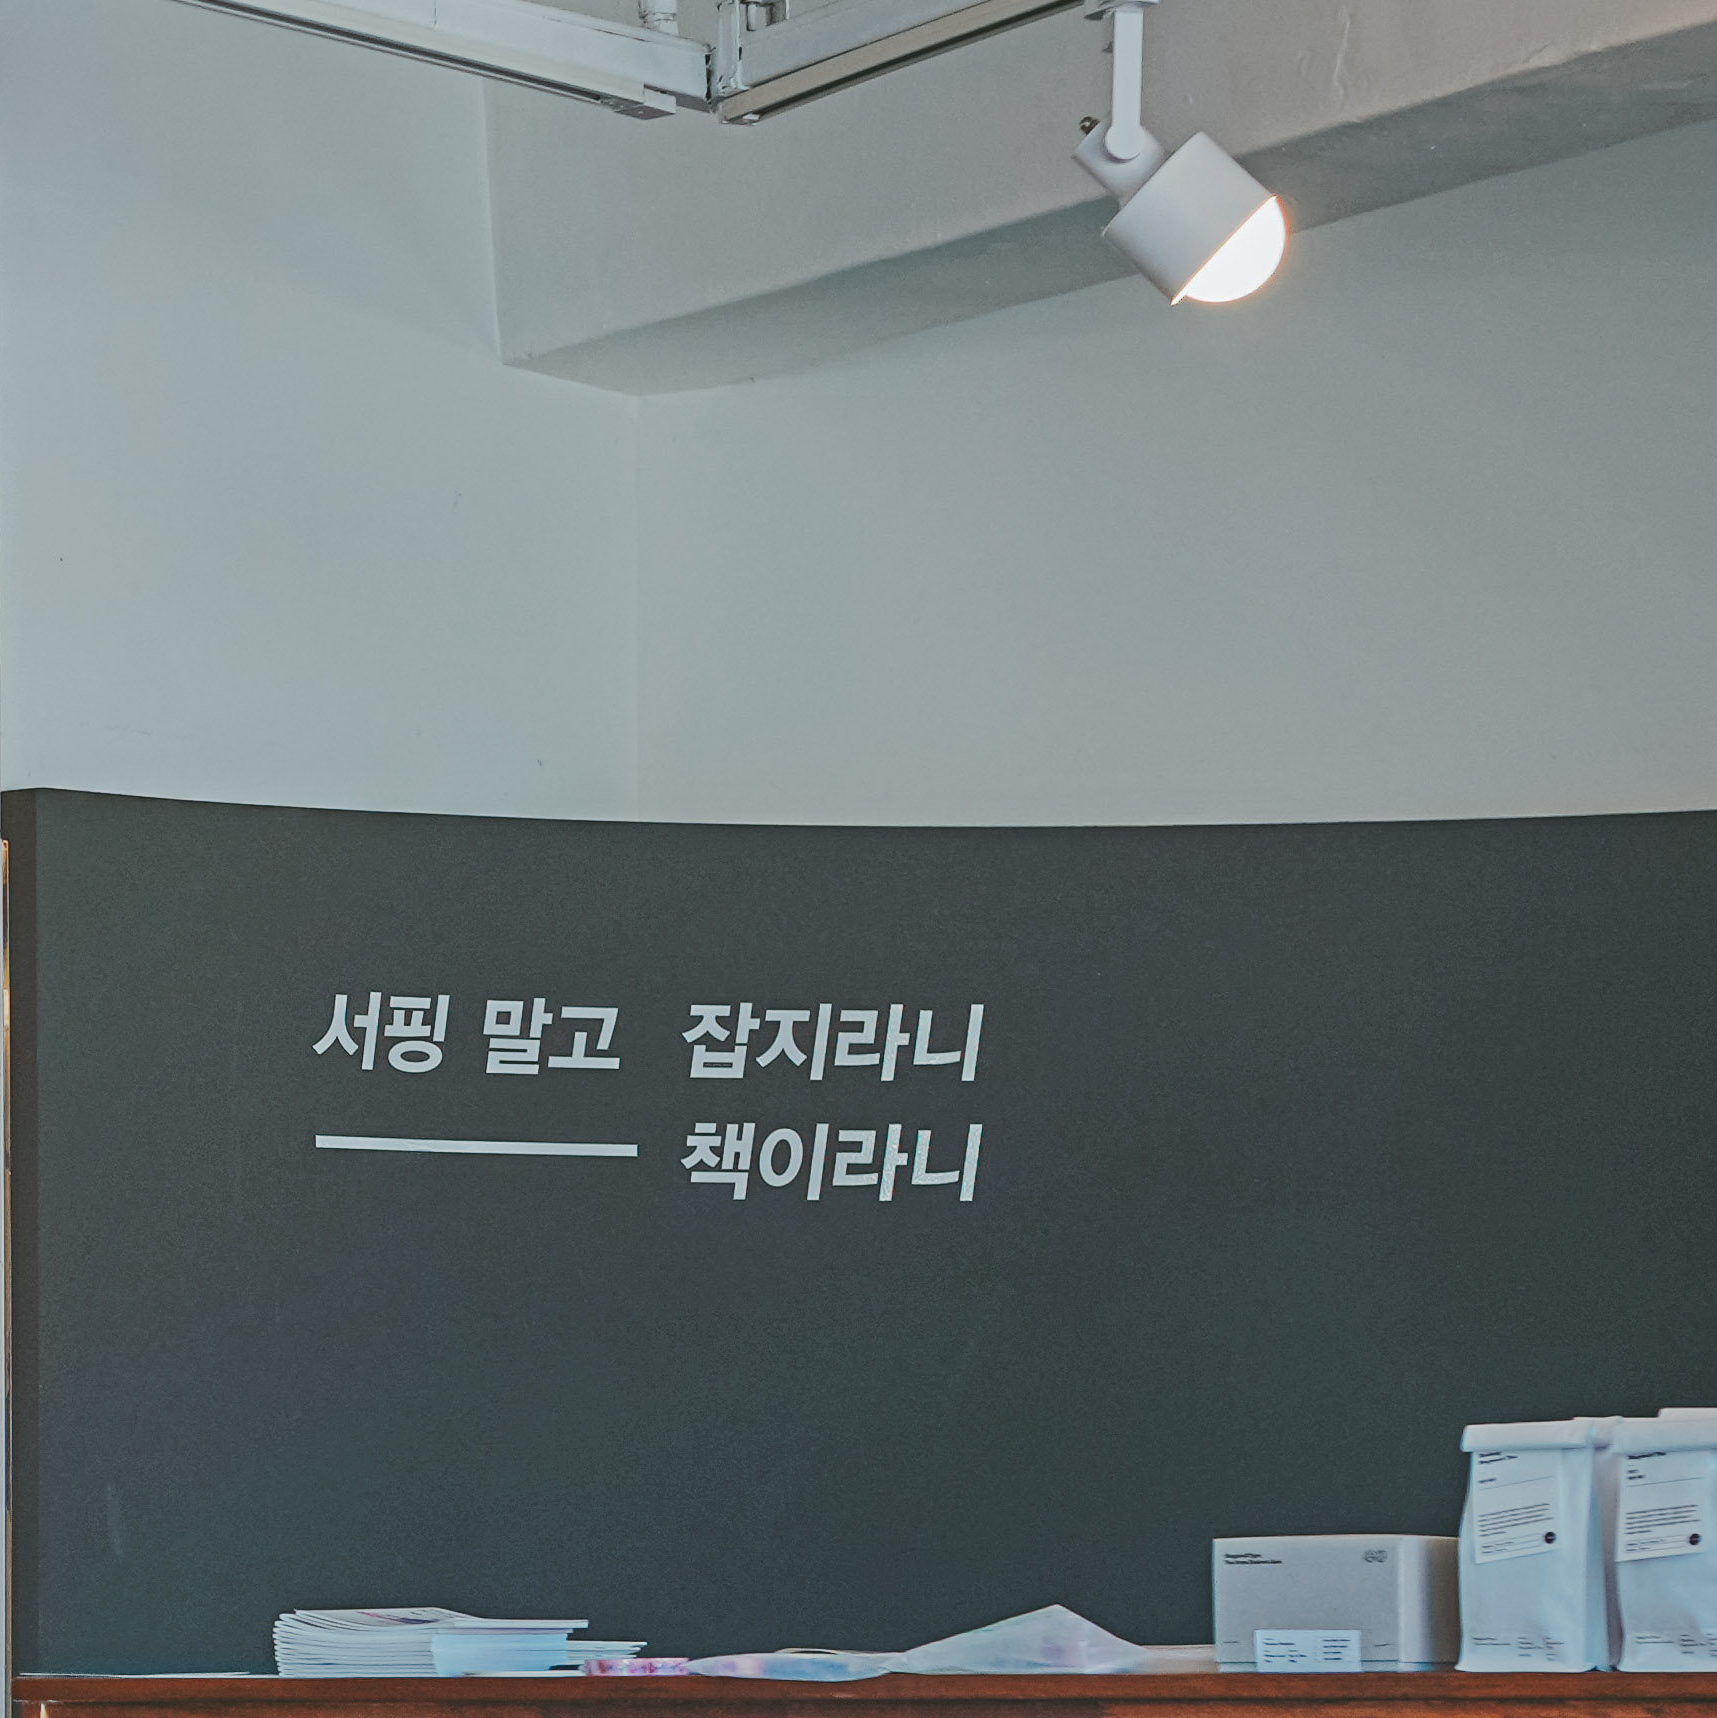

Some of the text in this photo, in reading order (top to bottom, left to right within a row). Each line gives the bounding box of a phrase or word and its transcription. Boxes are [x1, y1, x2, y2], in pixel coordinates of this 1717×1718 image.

[313, 991, 985, 1082] 서핑 말고 잡지라니
[681, 1122, 983, 1202] 책이라니
